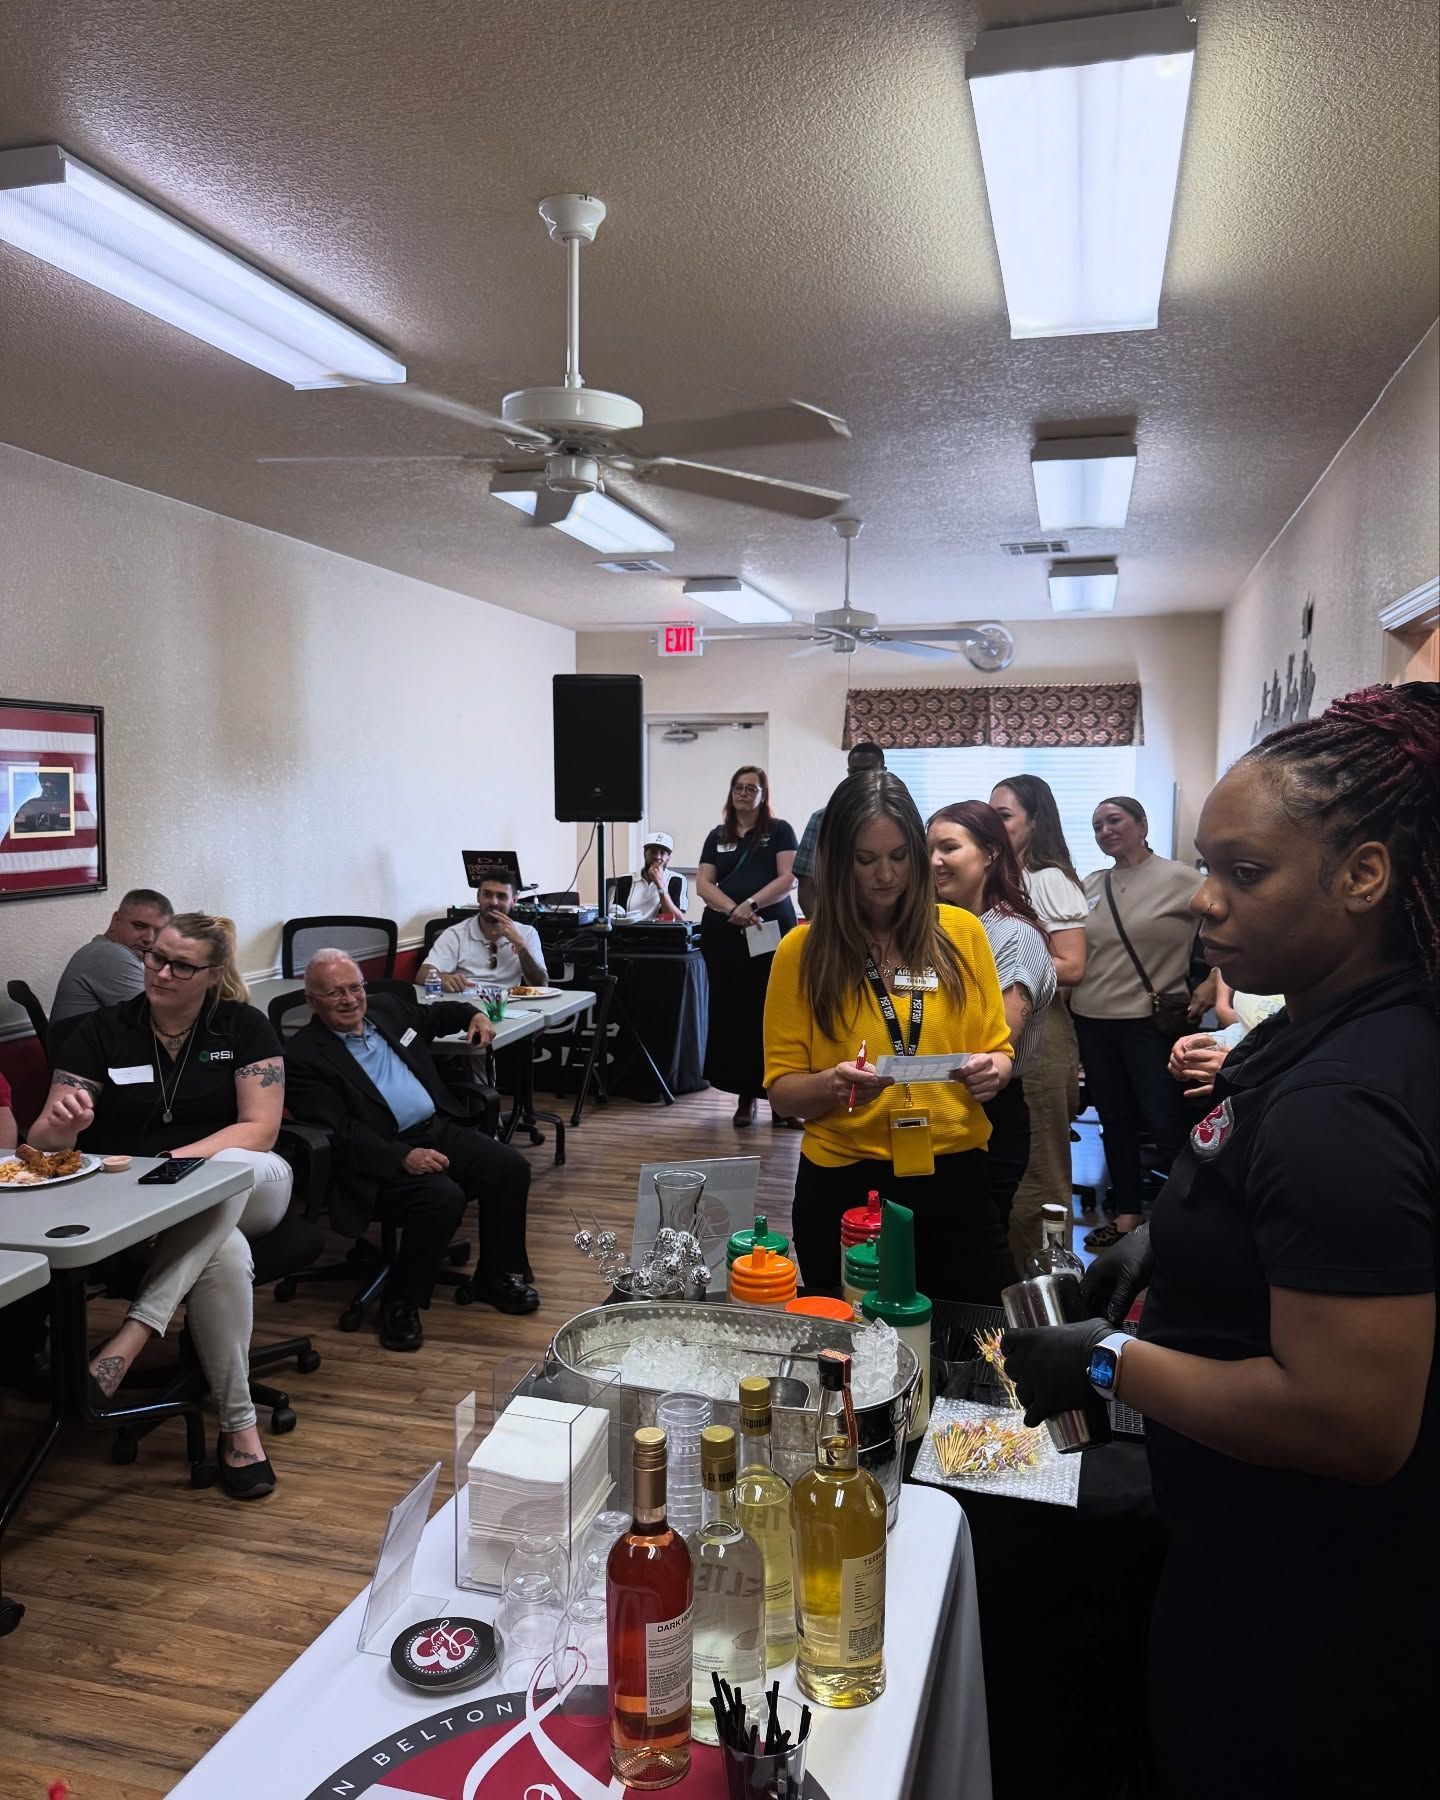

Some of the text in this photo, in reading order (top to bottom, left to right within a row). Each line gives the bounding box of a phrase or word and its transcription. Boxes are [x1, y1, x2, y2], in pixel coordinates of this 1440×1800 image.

[665, 627, 695, 652] EXIT
[911, 1010, 922, 1023] AREA
[657, 1618, 681, 1633] DARK
[371, 1701, 514, 1767] BELTON
